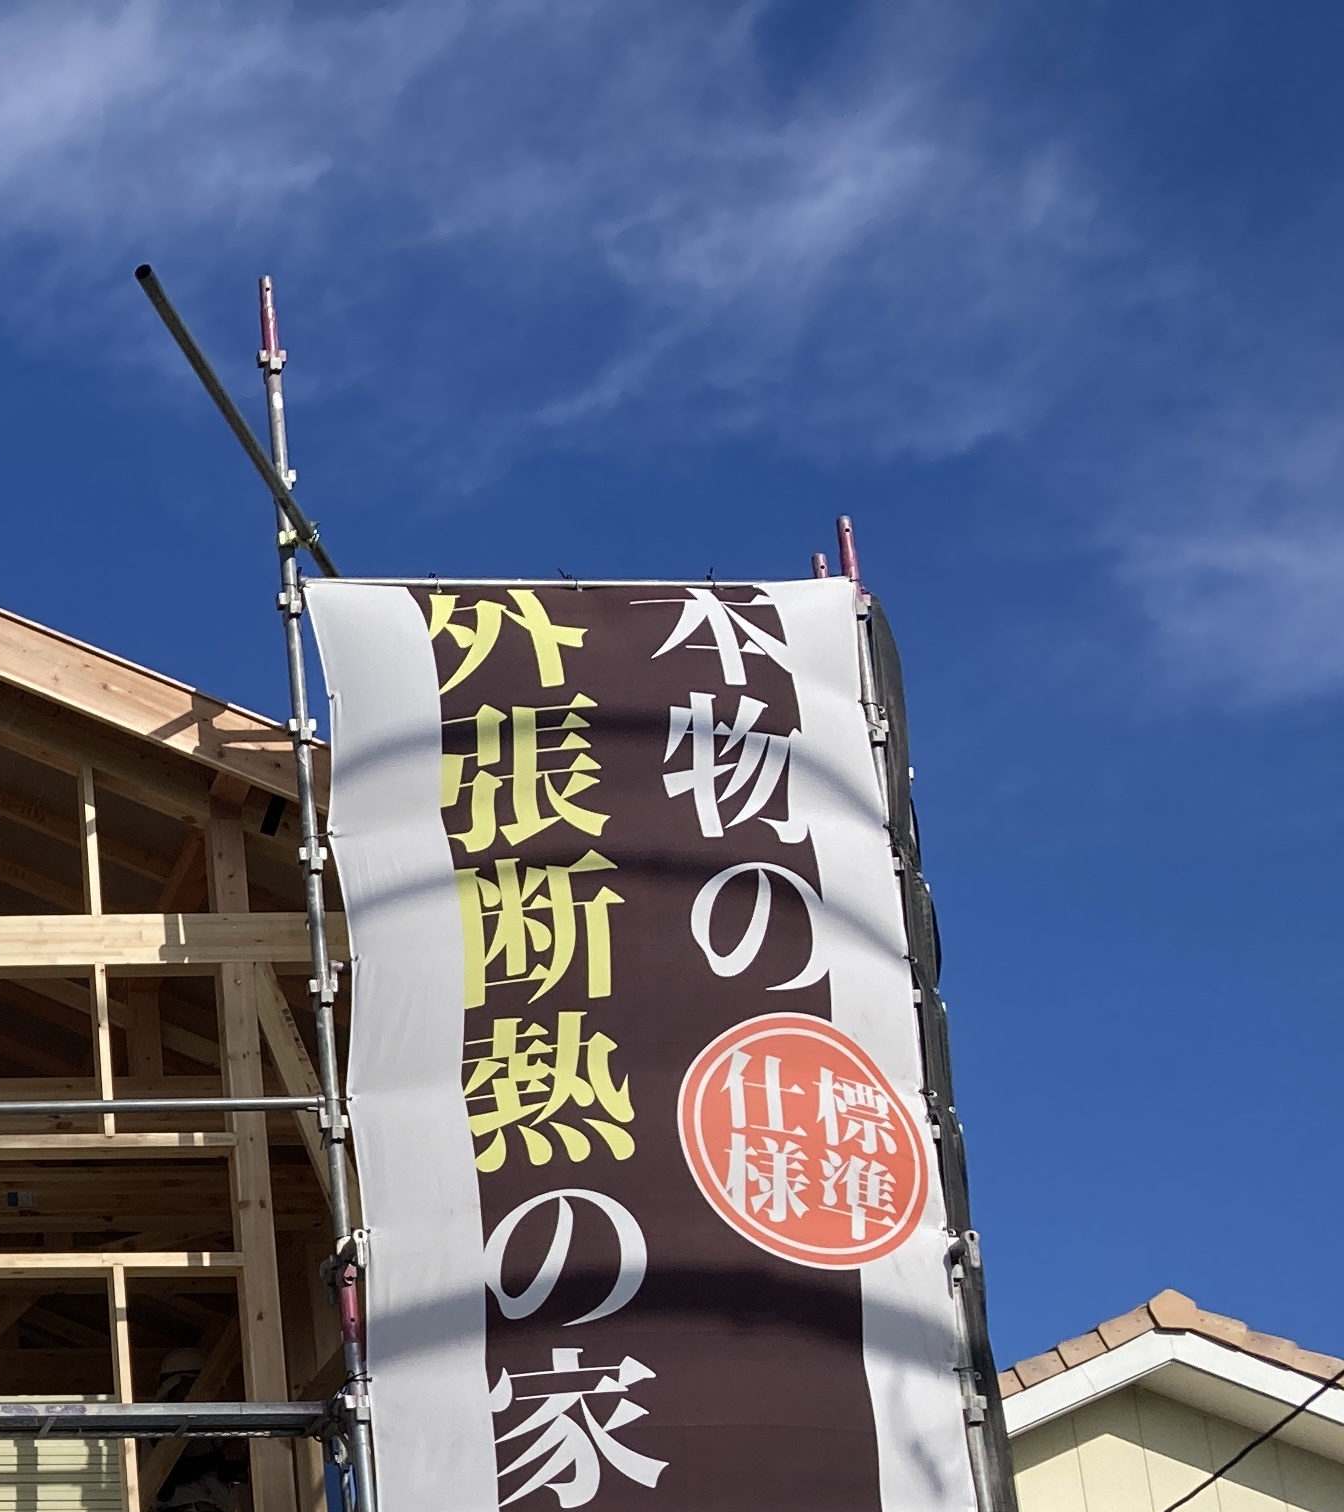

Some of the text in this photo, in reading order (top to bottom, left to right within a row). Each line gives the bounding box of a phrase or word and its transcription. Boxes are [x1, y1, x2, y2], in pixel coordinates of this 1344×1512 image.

[630, 587, 830, 991] 本物の
[428, 588, 670, 1509] 外張断熱の家
[721, 1049, 810, 1224] 仕様
[811, 1066, 898, 1241] 標準
